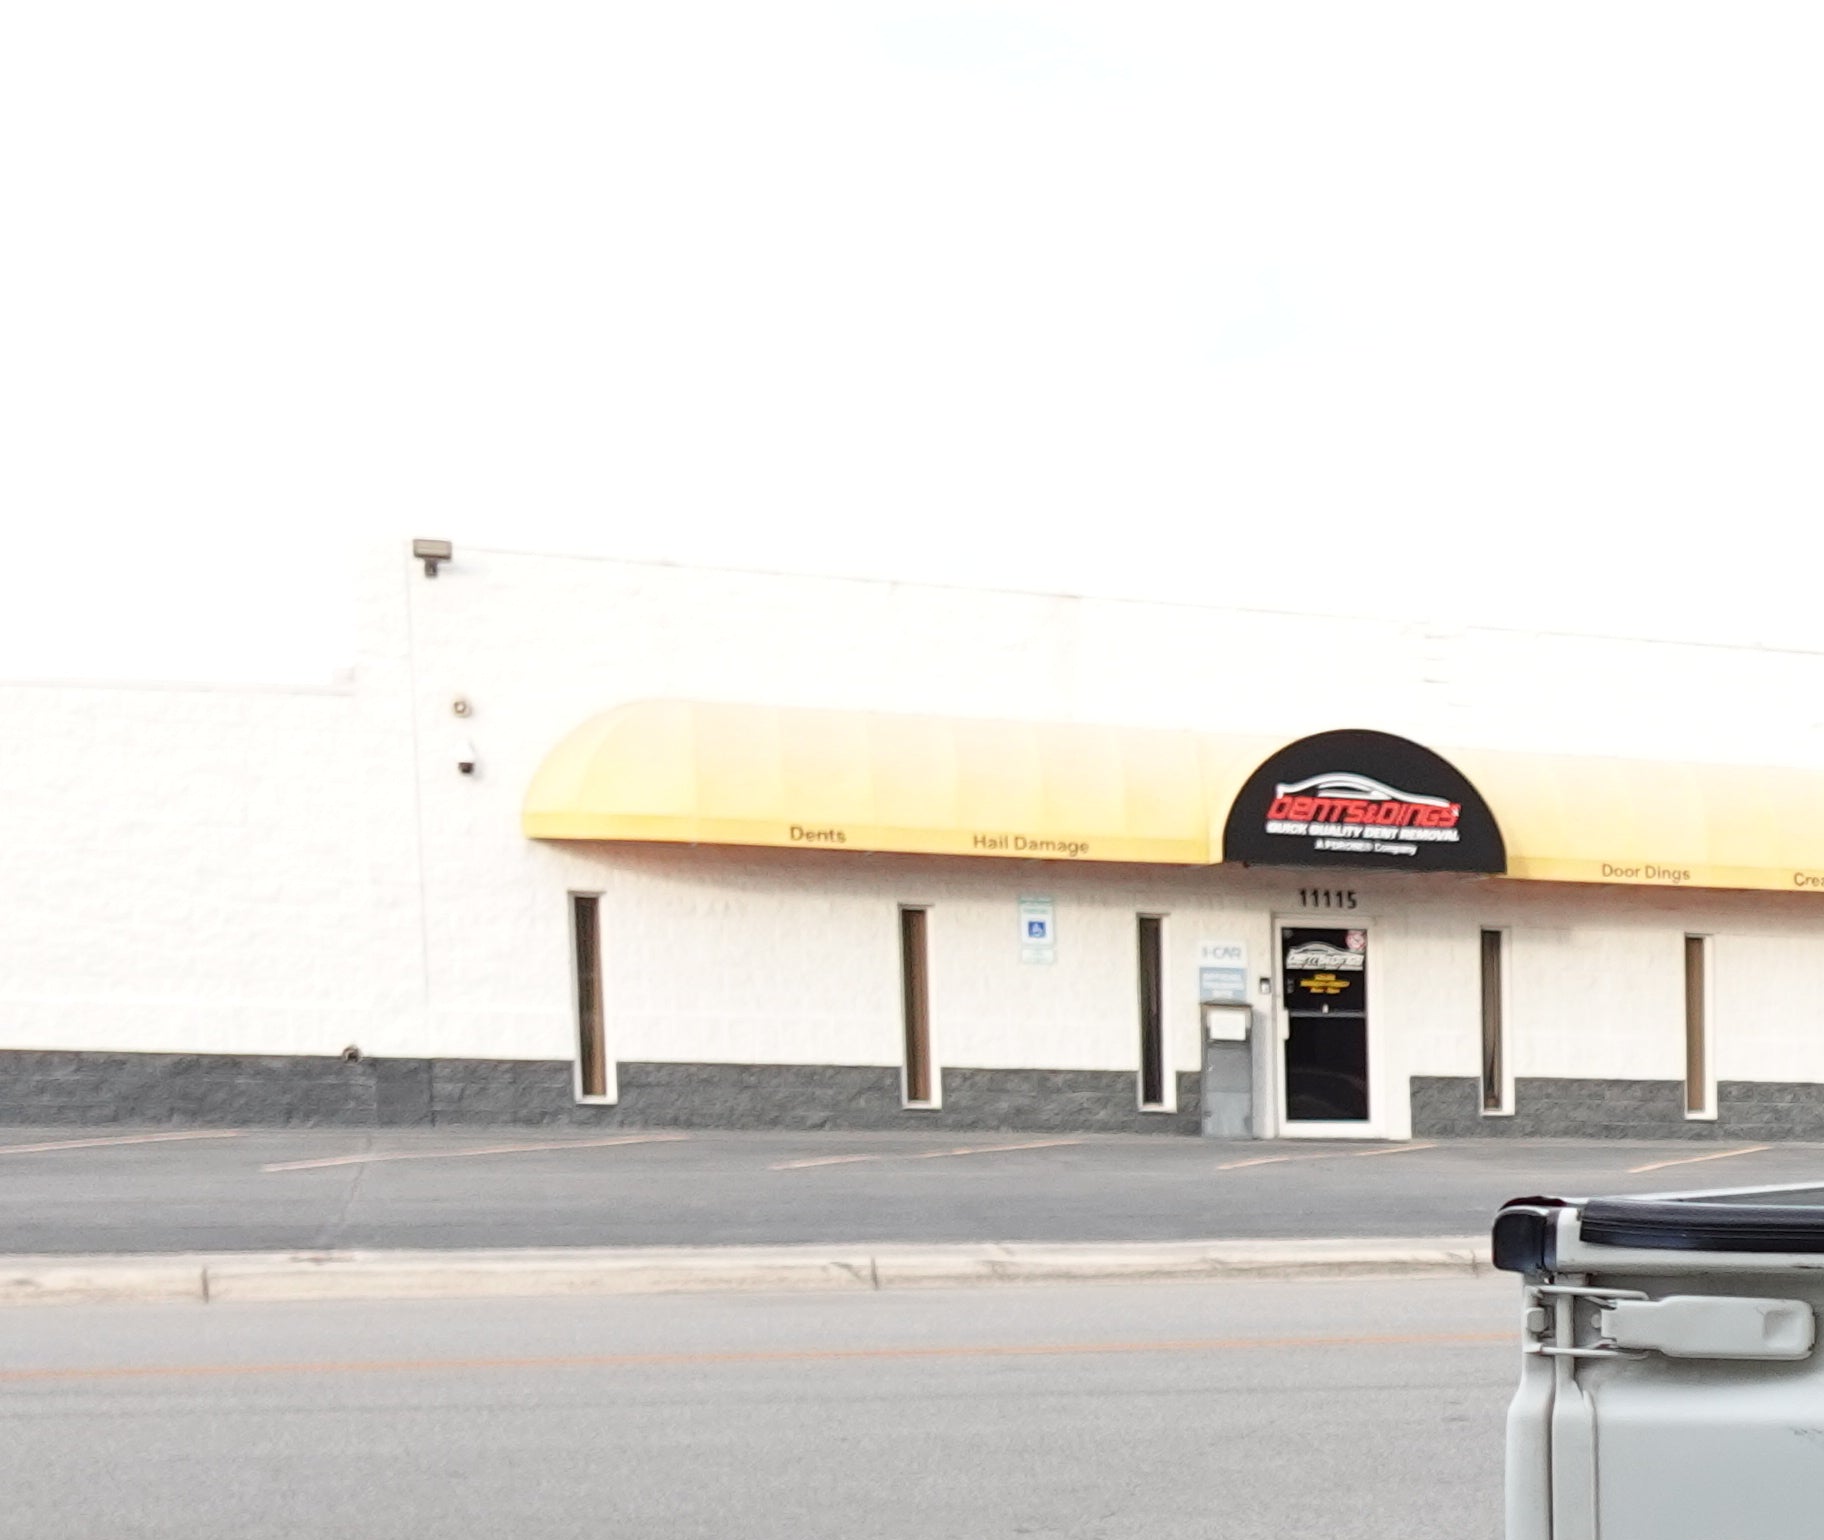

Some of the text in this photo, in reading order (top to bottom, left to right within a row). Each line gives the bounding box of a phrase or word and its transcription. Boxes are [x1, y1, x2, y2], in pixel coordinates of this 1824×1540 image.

[790, 826, 846, 843] Dents
[1265, 820, 1460, 842] QUICK QUALITY DENT REMOVAL
[973, 835, 1089, 856] Hail Damage
[1602, 864, 1691, 884] Door Dings
[1300, 889, 1358, 909] 11115
